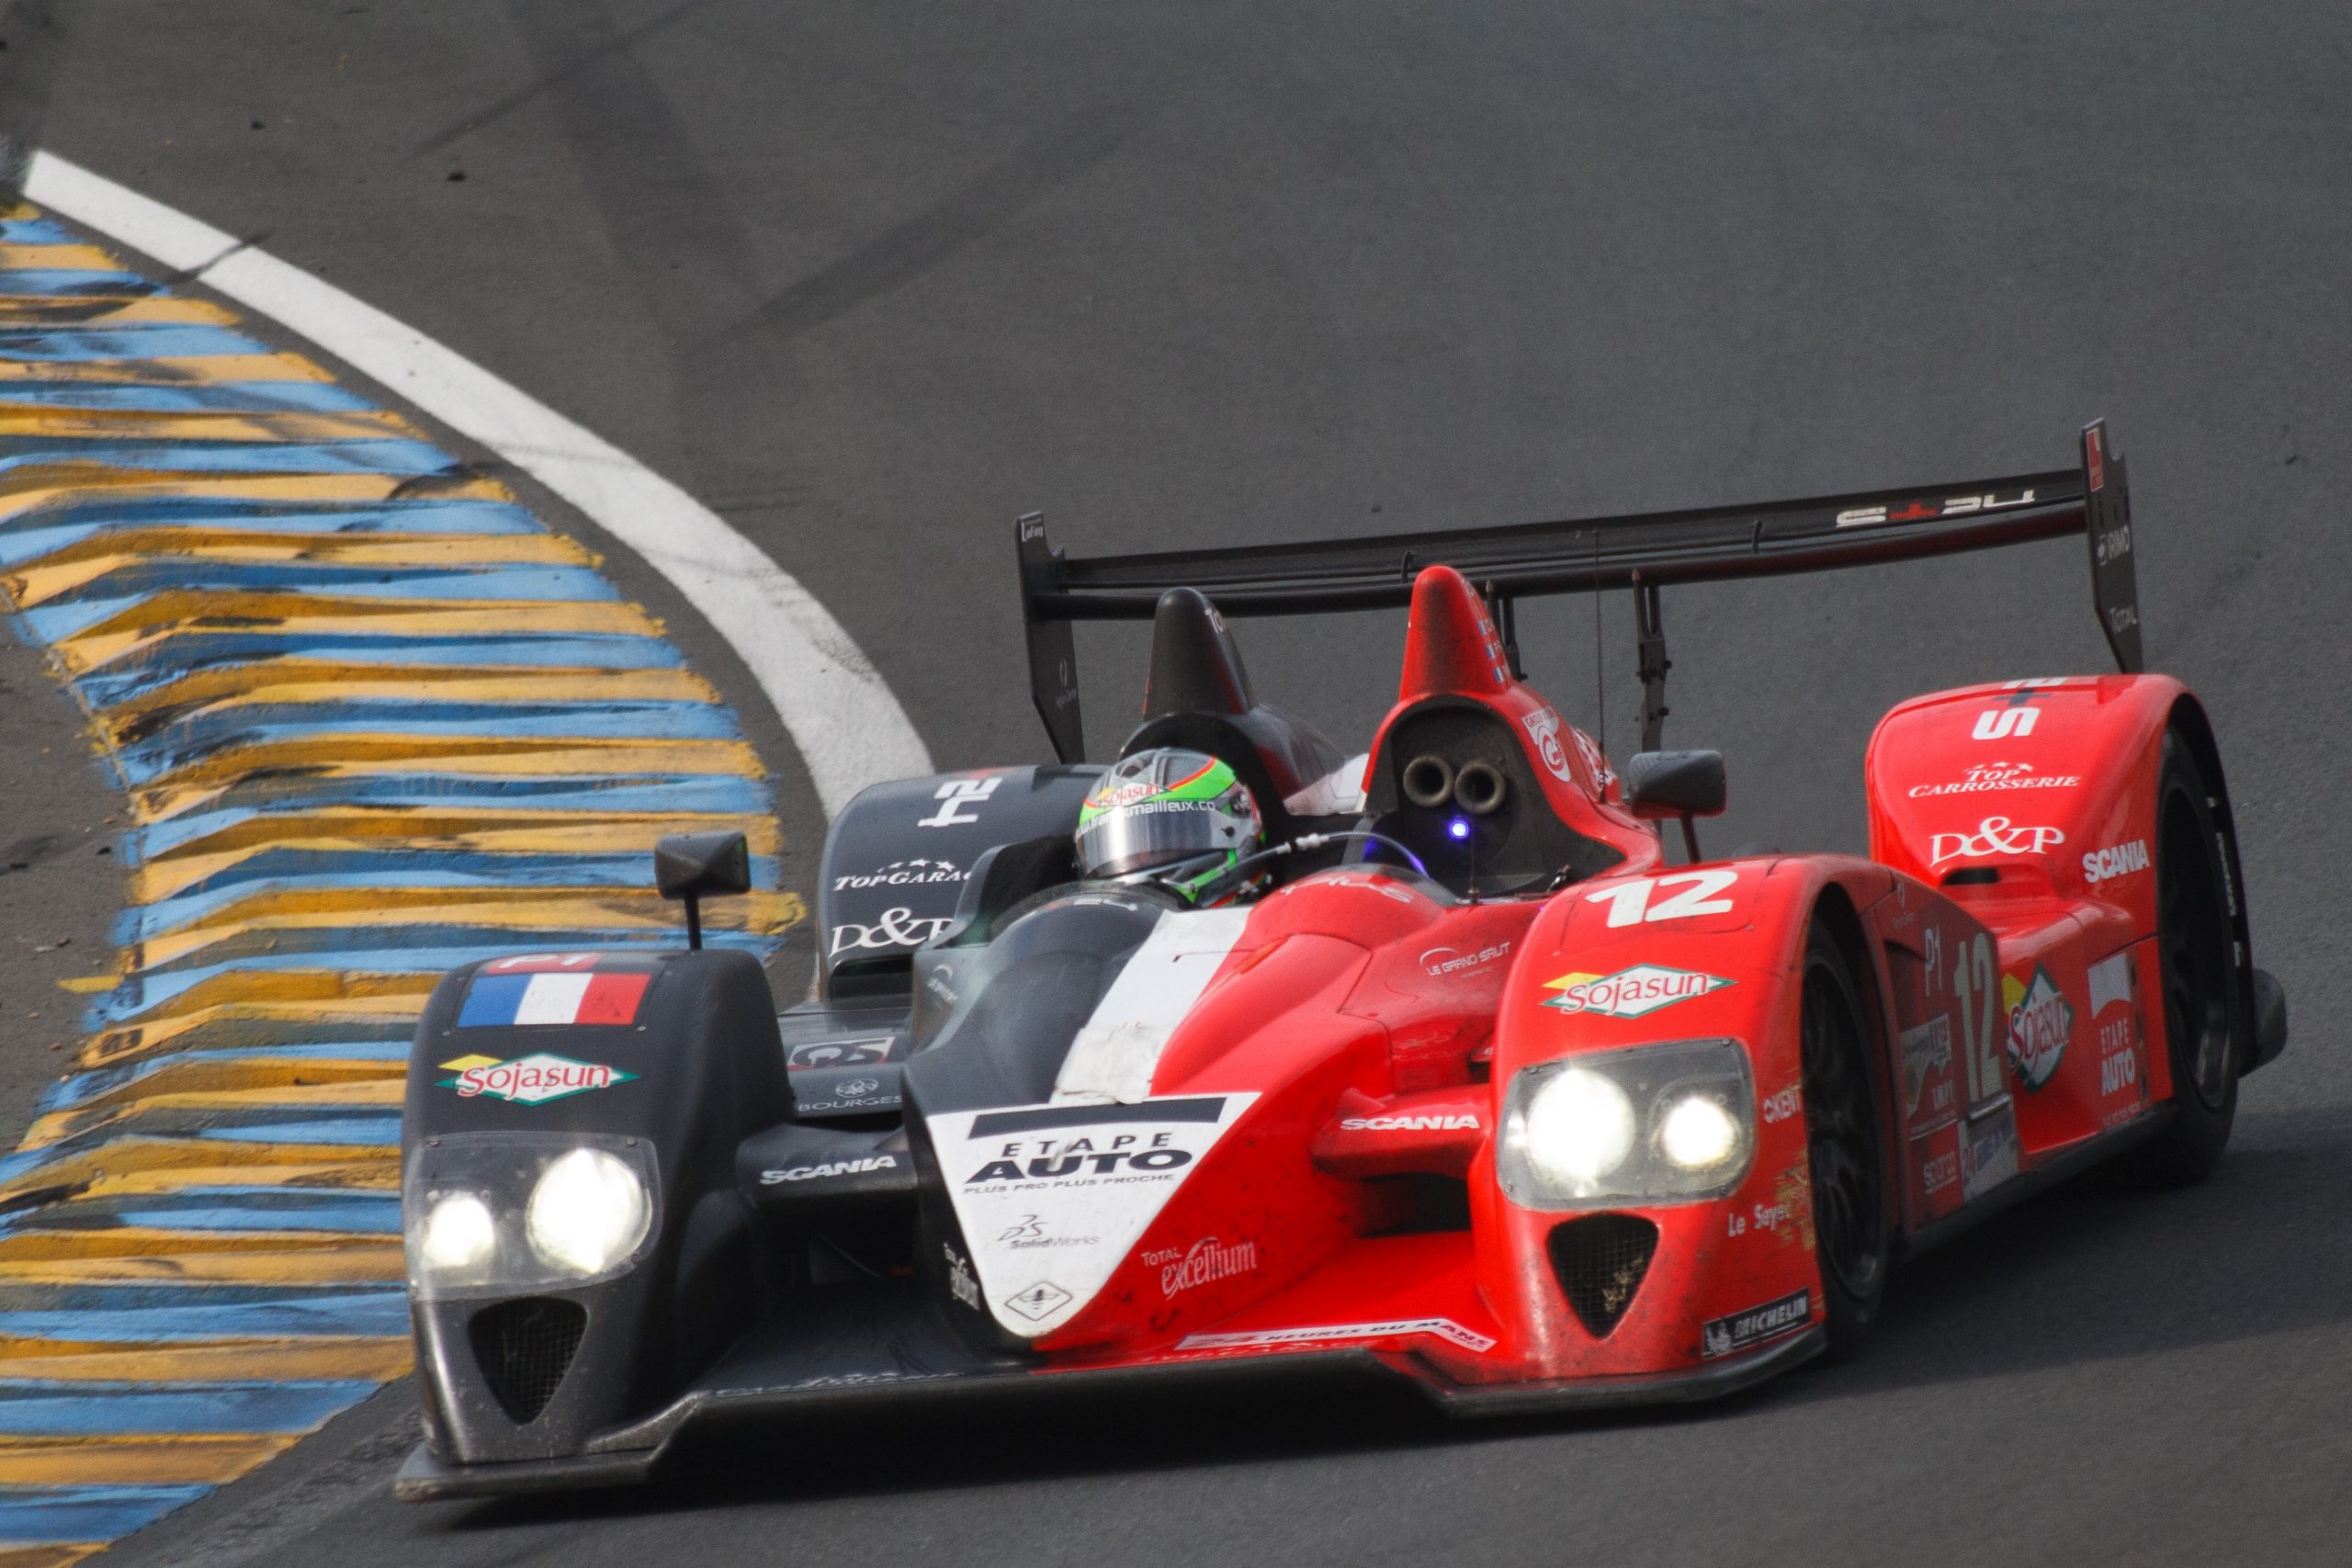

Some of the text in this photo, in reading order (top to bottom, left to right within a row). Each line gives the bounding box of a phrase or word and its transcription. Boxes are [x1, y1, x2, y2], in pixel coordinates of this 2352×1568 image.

[1908, 776, 2081, 798] CARROSSERIE
[1963, 769, 2021, 782] TOP
[1929, 816, 2065, 867] D&P
[2082, 839, 2150, 884] SCANIA
[1585, 871, 1738, 928] 12
[1925, 924, 1943, 998] P1
[1561, 974, 1708, 1014] Sojasun
[1954, 932, 2003, 1105] 12
[2100, 1018, 2130, 1055] ETAPE
[458, 1062, 610, 1098] Sojasun
[2101, 1048, 2135, 1097] AUTO
[798, 1095, 902, 1111] BOURGES
[1340, 1115, 1479, 1131] SCANIA
[1001, 1132, 1172, 1157] ETAPE
[760, 1156, 897, 1185] SCANIA
[964, 1174, 1175, 1195] PLUS PRO PLUS PROCHE
[965, 1149, 1193, 1184] AUTO
[1161, 1236, 1257, 1301] excellium
[1370, 1324, 1407, 1333] DU
[1415, 1321, 1490, 1347] MANS
[1734, 1296, 1807, 1338] MICHELIN
